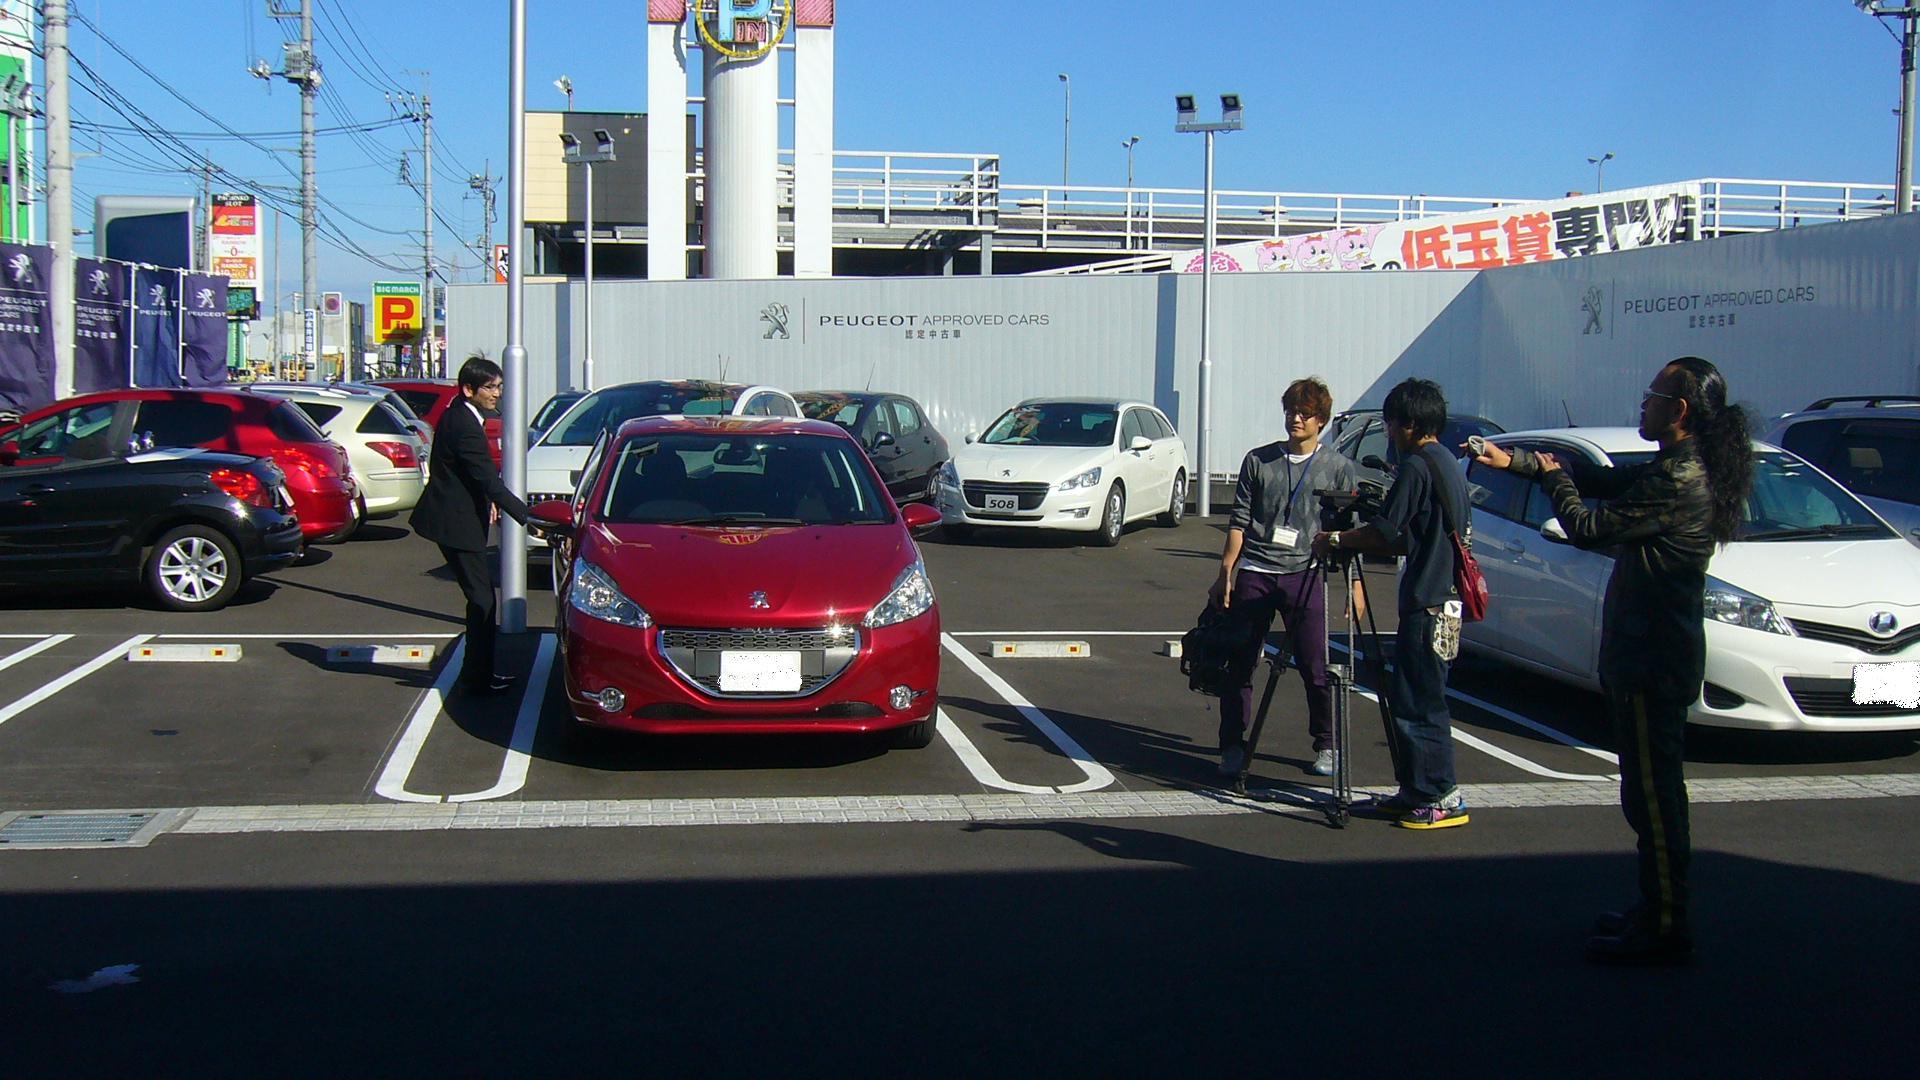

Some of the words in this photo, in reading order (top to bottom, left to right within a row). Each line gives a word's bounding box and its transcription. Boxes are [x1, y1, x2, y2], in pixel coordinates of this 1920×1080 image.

[736, 21, 766, 42] IN
[1624, 294, 1701, 315] PEUGEOT
[1703, 288, 1773, 308] APPROVED
[1776, 285, 1816, 304] CARS
[382, 297, 415, 330] P
[819, 315, 918, 327] PEUGEOT
[922, 315, 1004, 326] APPROVED
[1007, 314, 1050, 326] CARS
[988, 499, 1015, 509] 508
